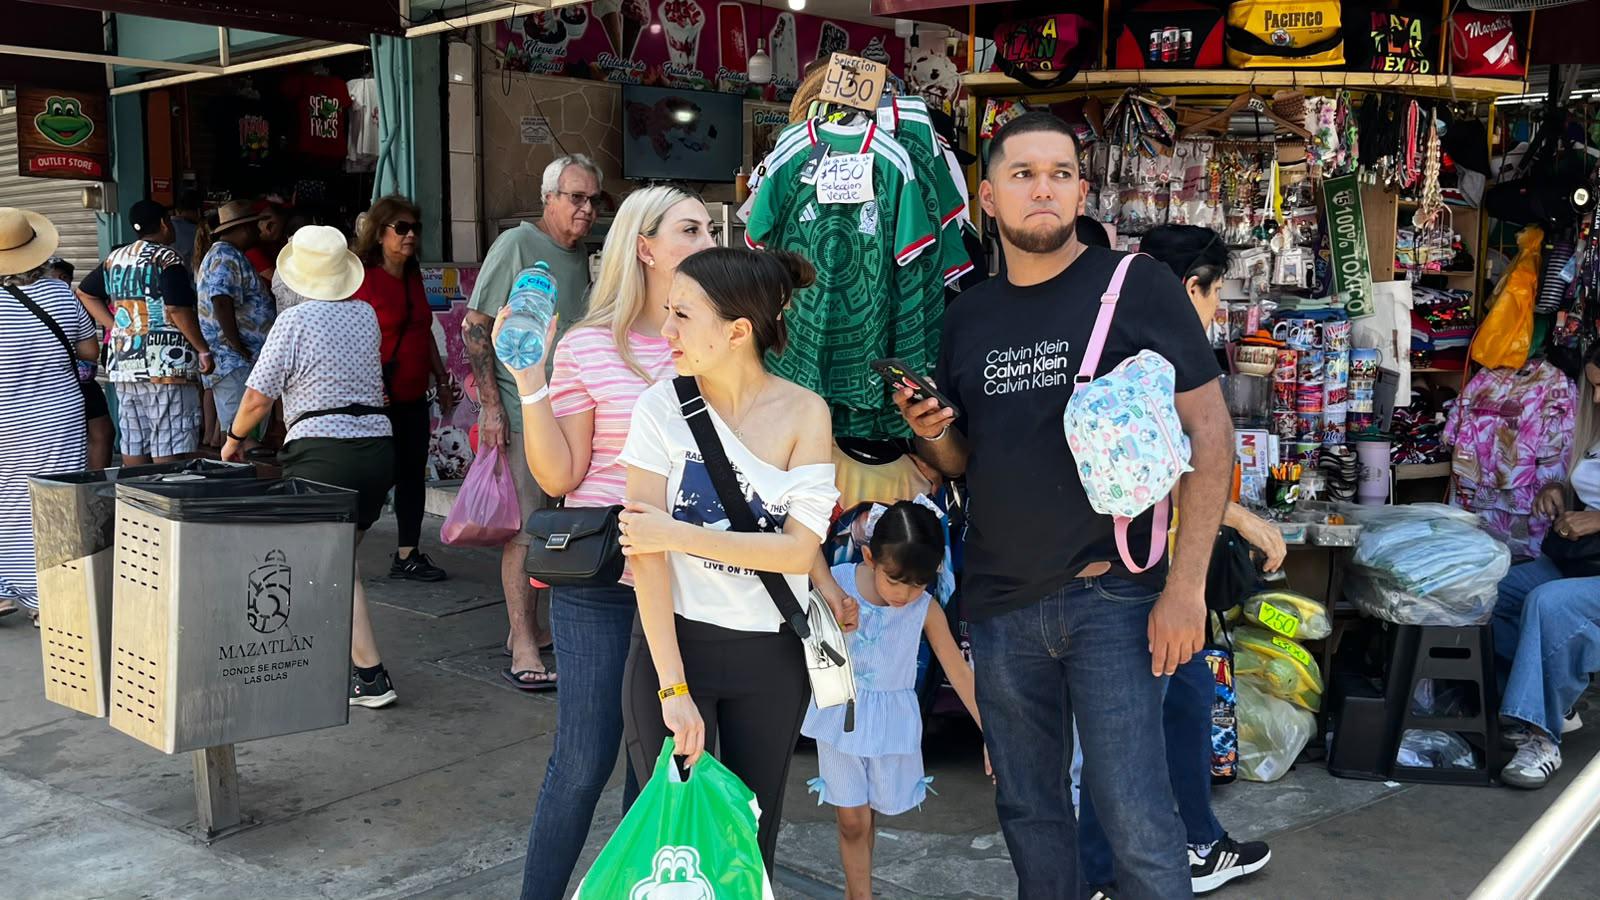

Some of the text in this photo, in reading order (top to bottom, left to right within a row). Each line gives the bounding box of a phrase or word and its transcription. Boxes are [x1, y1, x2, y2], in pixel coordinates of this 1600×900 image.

[1264, 10, 1323, 32] PACIFICO
[37, 157, 93, 170] OUTLET STORE
[1335, 207, 1357, 248] 100%
[986, 339, 1069, 364] Calvin Klein
[984, 355, 1067, 379] Calvin Klein
[984, 371, 1067, 395] Calvin Klein
[703, 561, 724, 571] LIVE
[727, 565, 741, 574] ON
[1264, 605, 1296, 634] 250
[222, 658, 309, 677] DONDE SE ROMPEN
[244, 671, 288, 685] LAS OLAS
